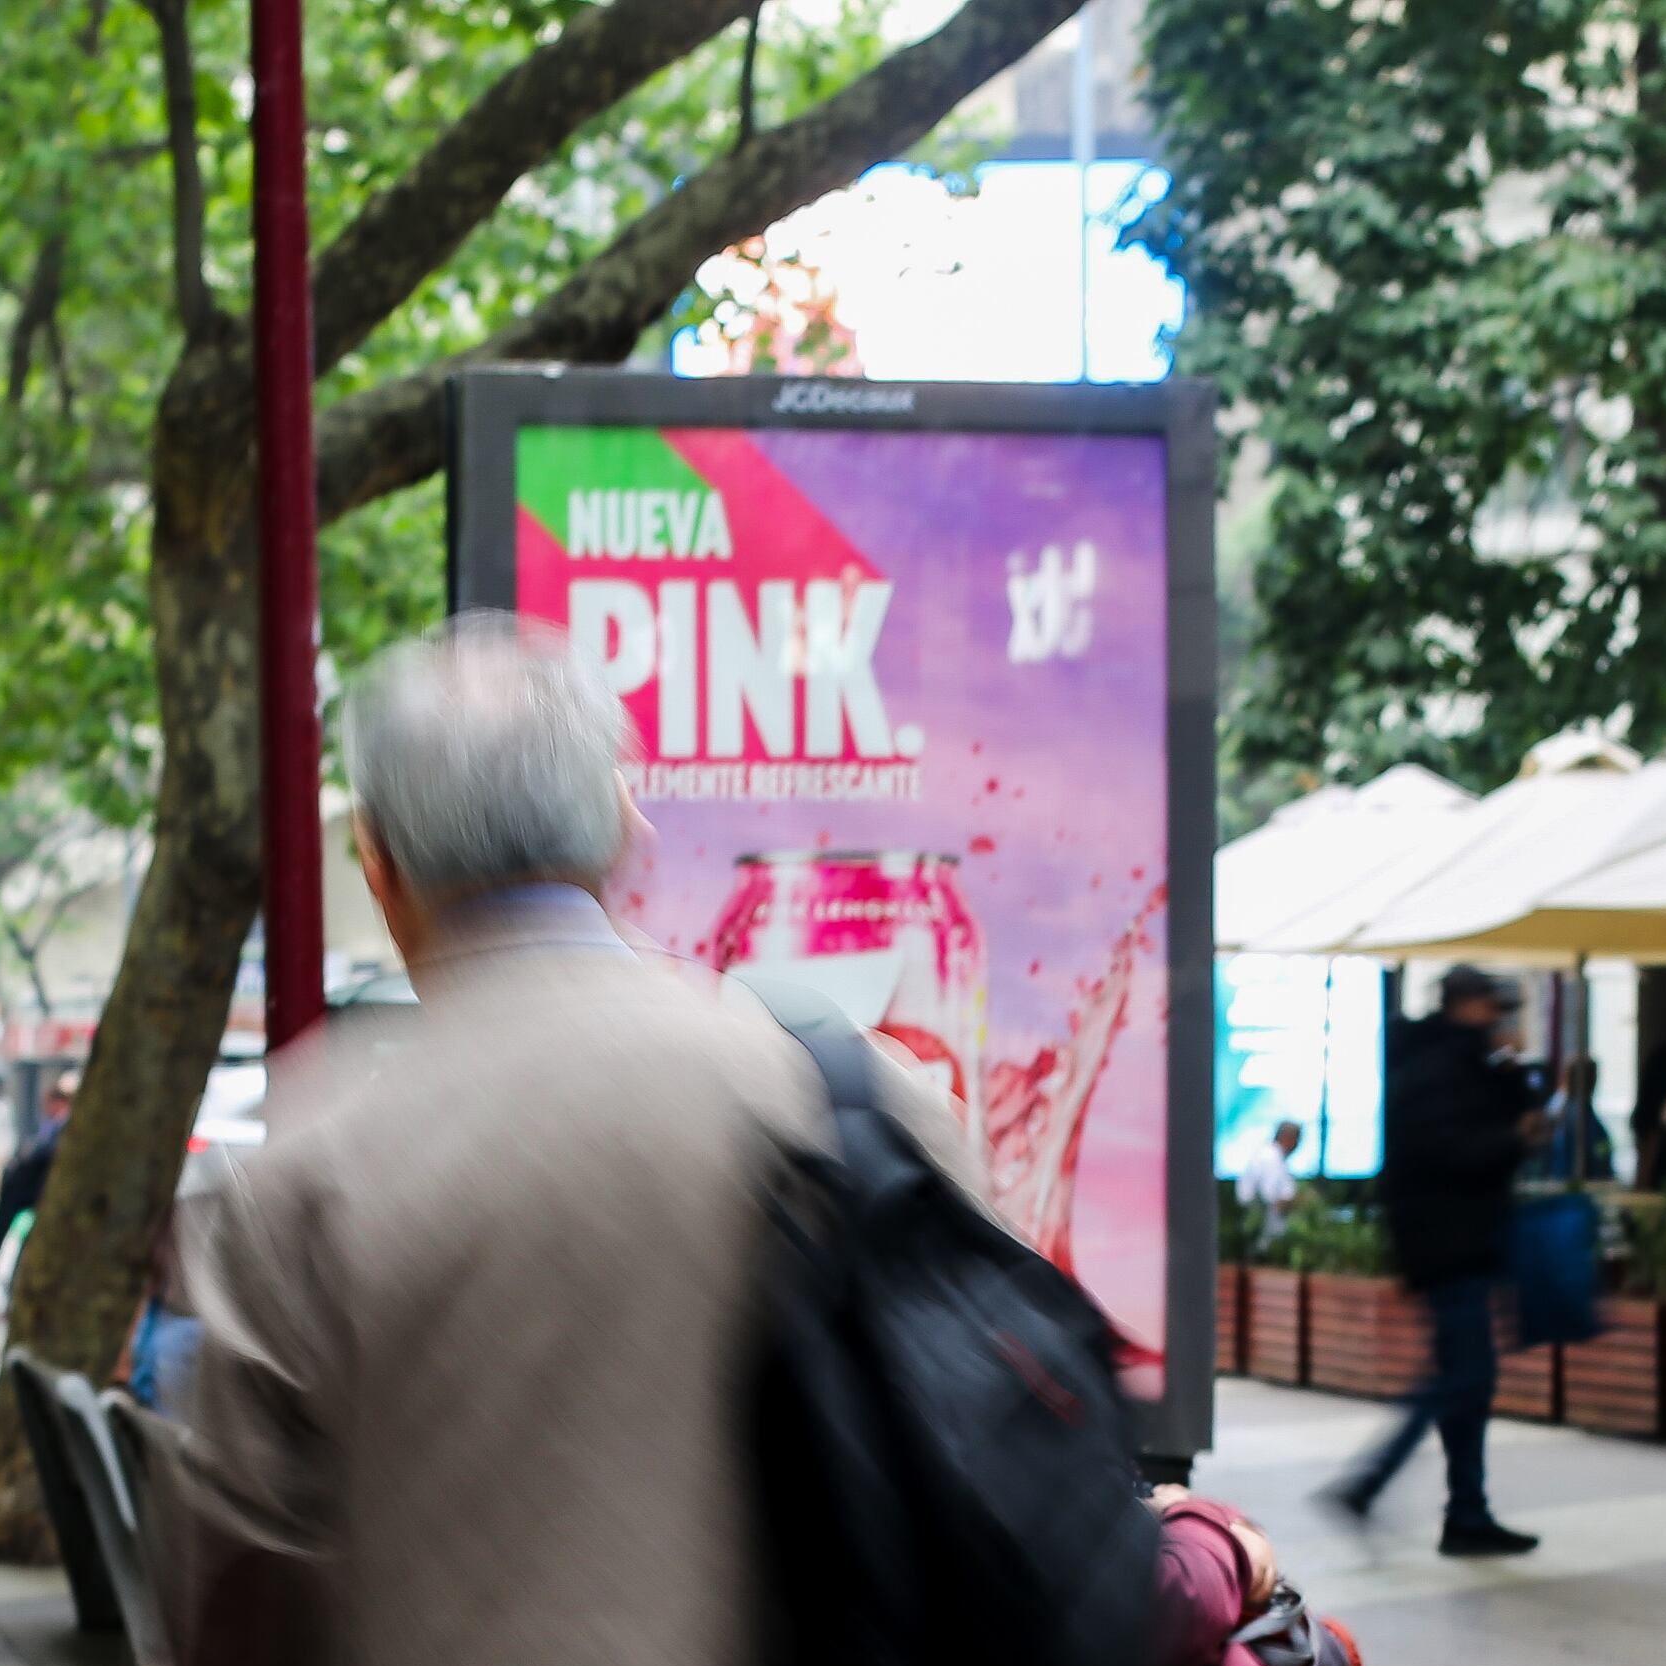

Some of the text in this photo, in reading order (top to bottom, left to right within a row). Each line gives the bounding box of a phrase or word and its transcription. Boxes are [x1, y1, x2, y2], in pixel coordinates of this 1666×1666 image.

[566, 488, 733, 561] NUEVA
[566, 577, 925, 758] PINK.
[750, 763, 923, 802] REFRESCANTE
